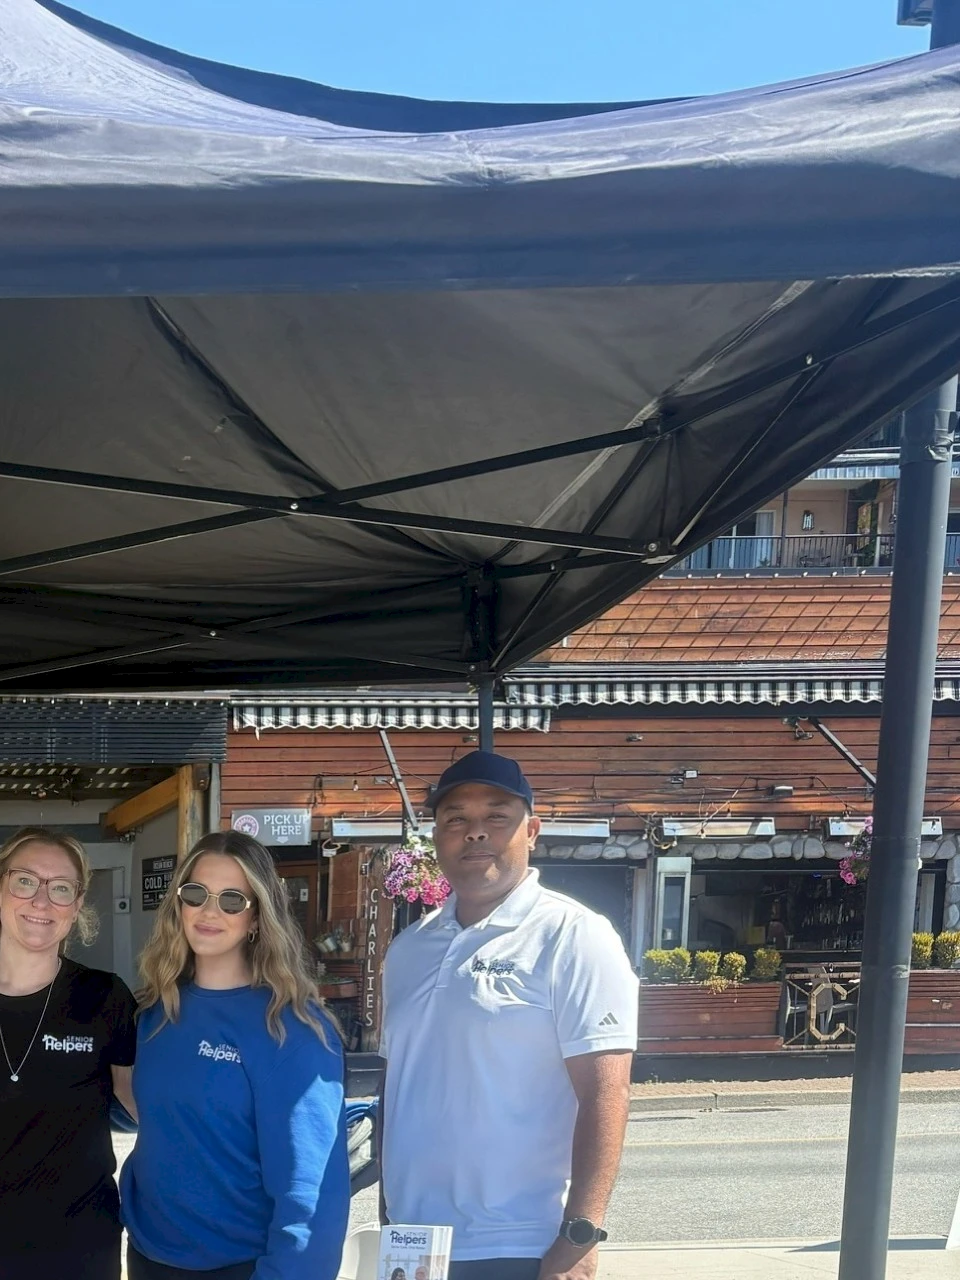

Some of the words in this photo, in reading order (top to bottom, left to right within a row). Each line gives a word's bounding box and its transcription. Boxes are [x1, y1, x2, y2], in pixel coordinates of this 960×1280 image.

[263, 814, 291, 825] PICK
[293, 814, 309, 825] UP
[271, 825, 302, 836] HERE
[144, 876, 162, 890] COLD
[365, 888, 378, 1027] CHARLIES
[44, 1038, 93, 1053] Helpers
[390, 1234, 427, 1246] Helpers
